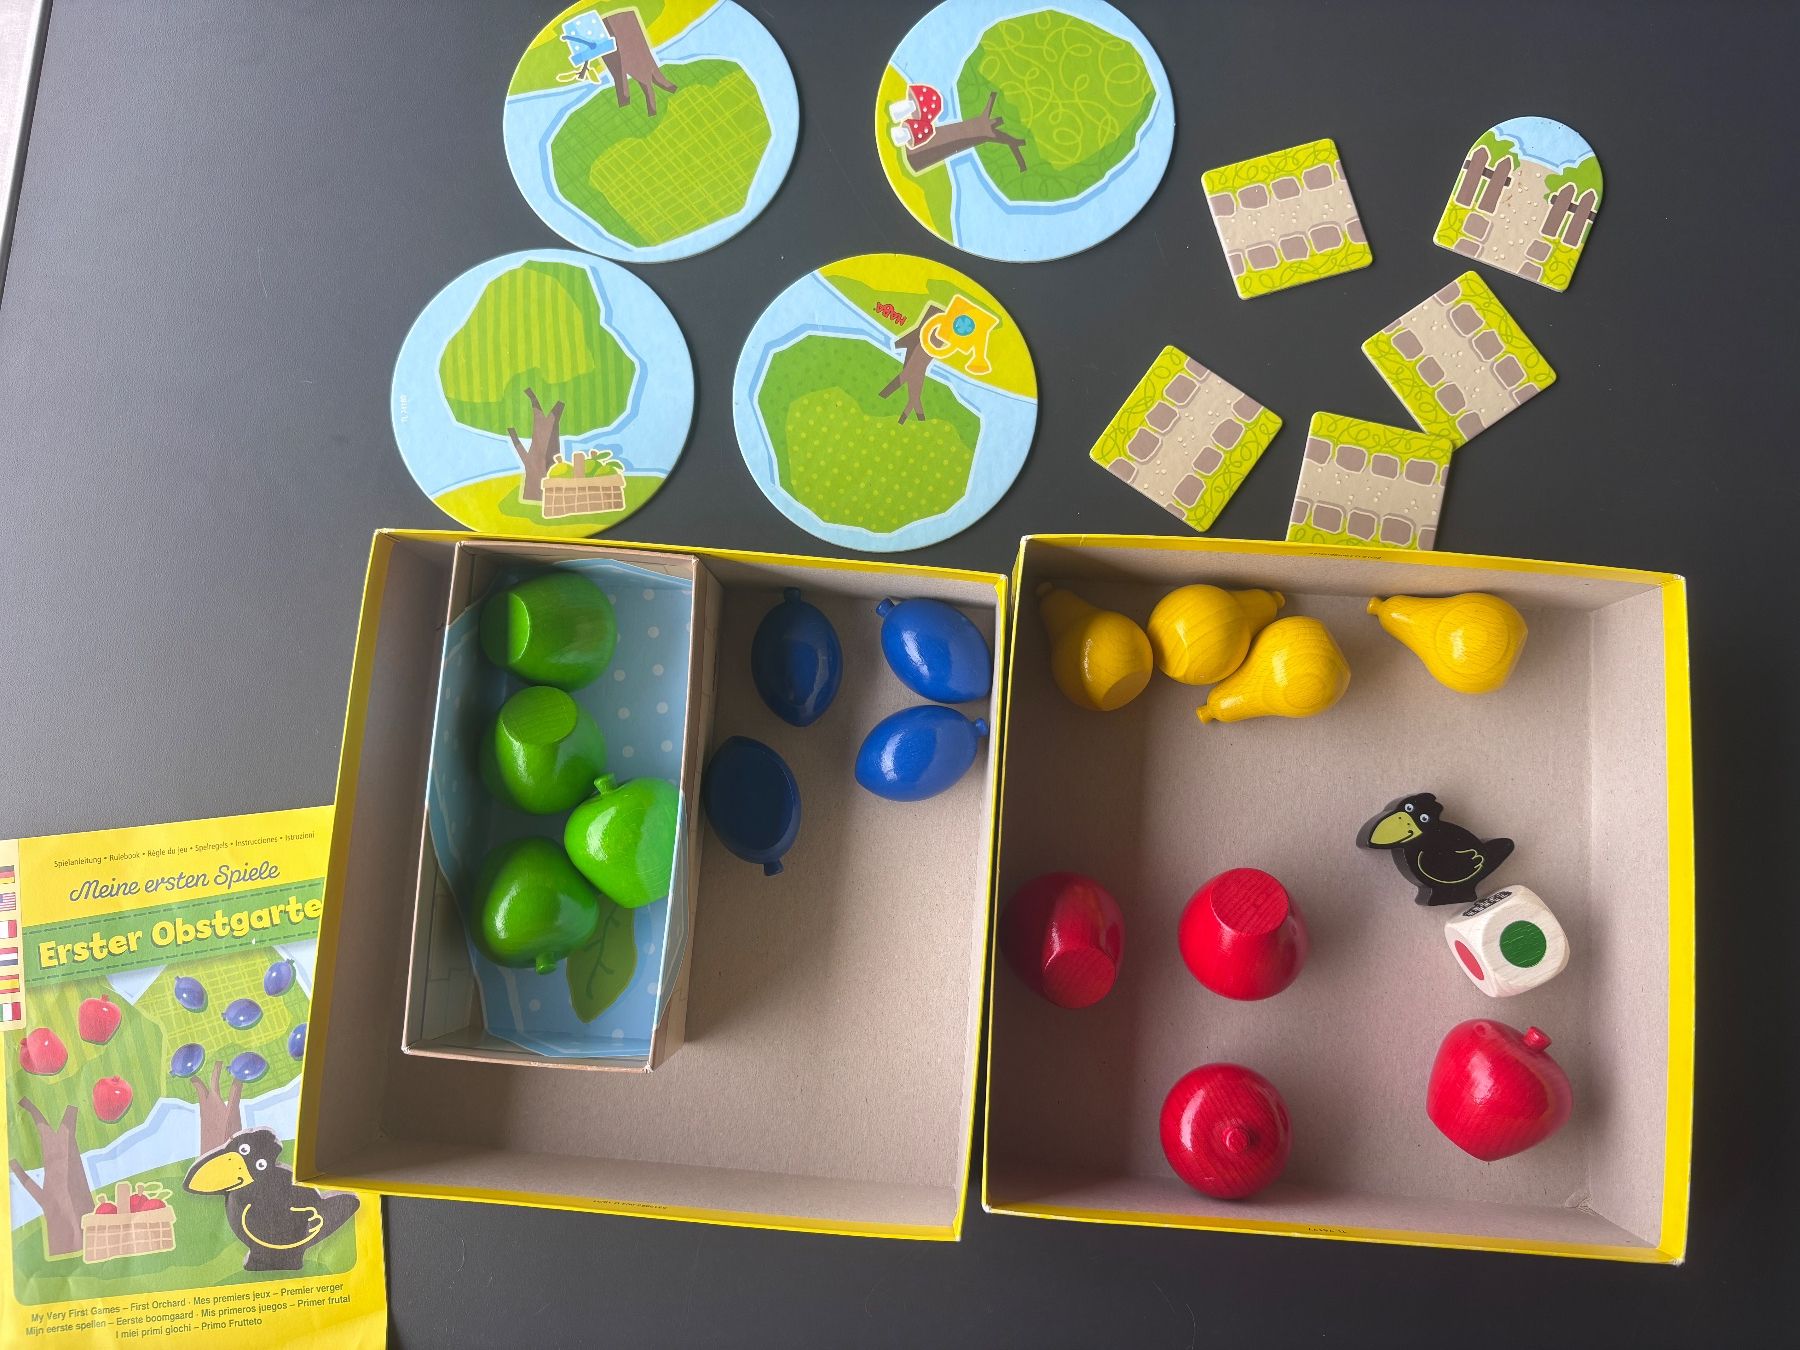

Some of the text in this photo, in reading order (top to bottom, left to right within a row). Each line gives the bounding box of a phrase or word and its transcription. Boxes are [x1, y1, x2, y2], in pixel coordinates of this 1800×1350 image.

[876, 302, 907, 326] HABA
[54, 830, 315, 868] Spielanleitung Rulebook Règle du jeu Spelregels Instrucciones Istruzioni
[69, 860, 281, 902] Meine ersten Spiele
[38, 896, 324, 970] Erster Obstgarte
[25, 1327, 44, 1337] Mijn
[46, 1323, 74, 1333] eerste
[75, 1320, 107, 1331] spellen
[116, 1316, 144, 1326] Eerste
[145, 1310, 194, 1322] boomgaard
[201, 1308, 216, 1318] Mis
[218, 1305, 257, 1317] primeros
[258, 1302, 288, 1314] juegos
[297, 1298, 326, 1308] Primer
[328, 1294, 351, 1304] frutal
[31, 1313, 44, 1324] My
[46, 1311, 67, 1321] Very
[68, 1308, 88, 1318] First
[90, 1306, 121, 1315] Games
[130, 1302, 150, 1312] First
[151, 1298, 186, 1309] Orchard
[193, 1296, 211, 1306] Mes
[213, 1293, 251, 1305] premiers
[252, 1290, 271, 1301] jeux
[280, 1285, 314, 1296] Premier
[316, 1283, 344, 1294] verger
[115, 1330, 119, 1339] I
[121, 1329, 139, 1338] miei
[141, 1326, 163, 1338] primi
[165, 1323, 192, 1336] giochi
[201, 1321, 227, 1331] Primo
[228, 1318, 263, 1328] Frutteto
